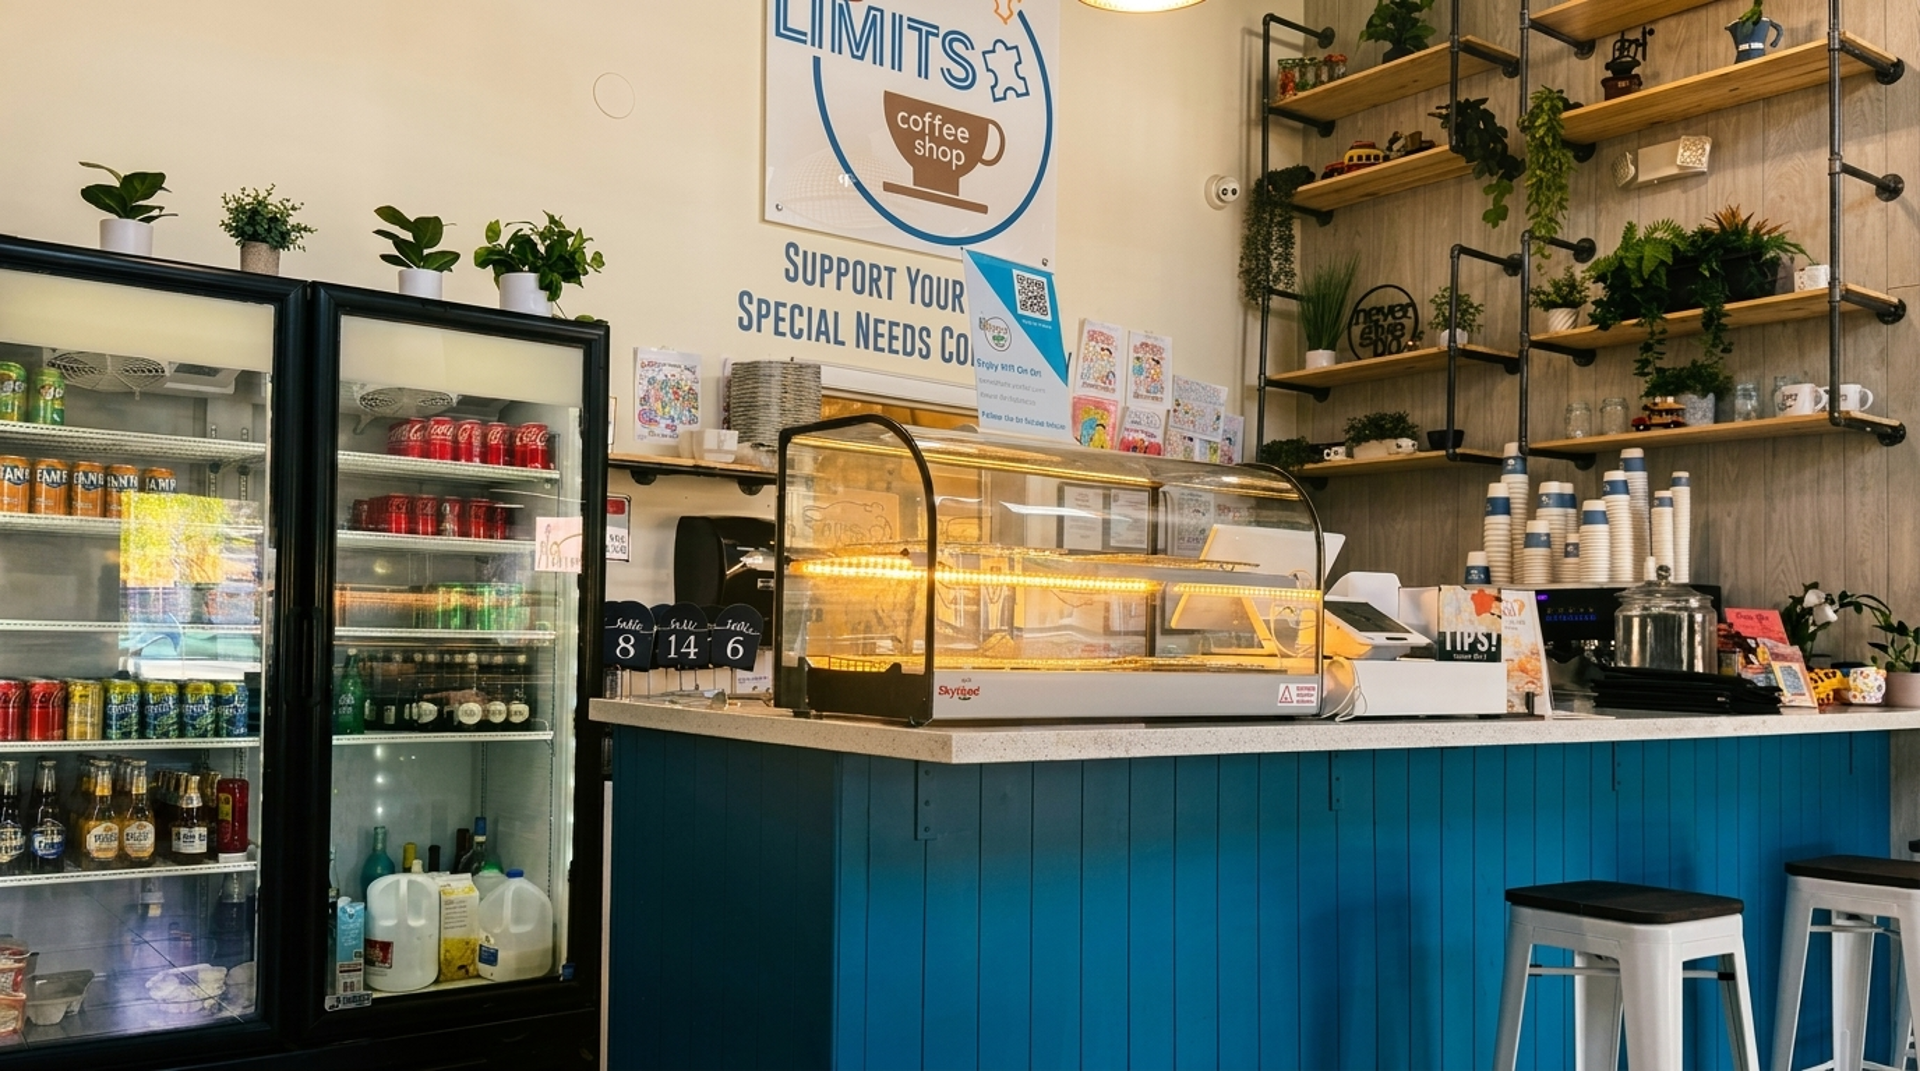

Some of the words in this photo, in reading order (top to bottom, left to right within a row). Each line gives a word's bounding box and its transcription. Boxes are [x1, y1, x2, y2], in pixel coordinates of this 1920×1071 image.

[774, 0, 977, 91] LIMITS
[897, 110, 970, 144] coffee
[914, 138, 966, 171] shop
[615, 634, 636, 659] 8
[667, 634, 699, 660] 14
[726, 636, 745, 660] 6
